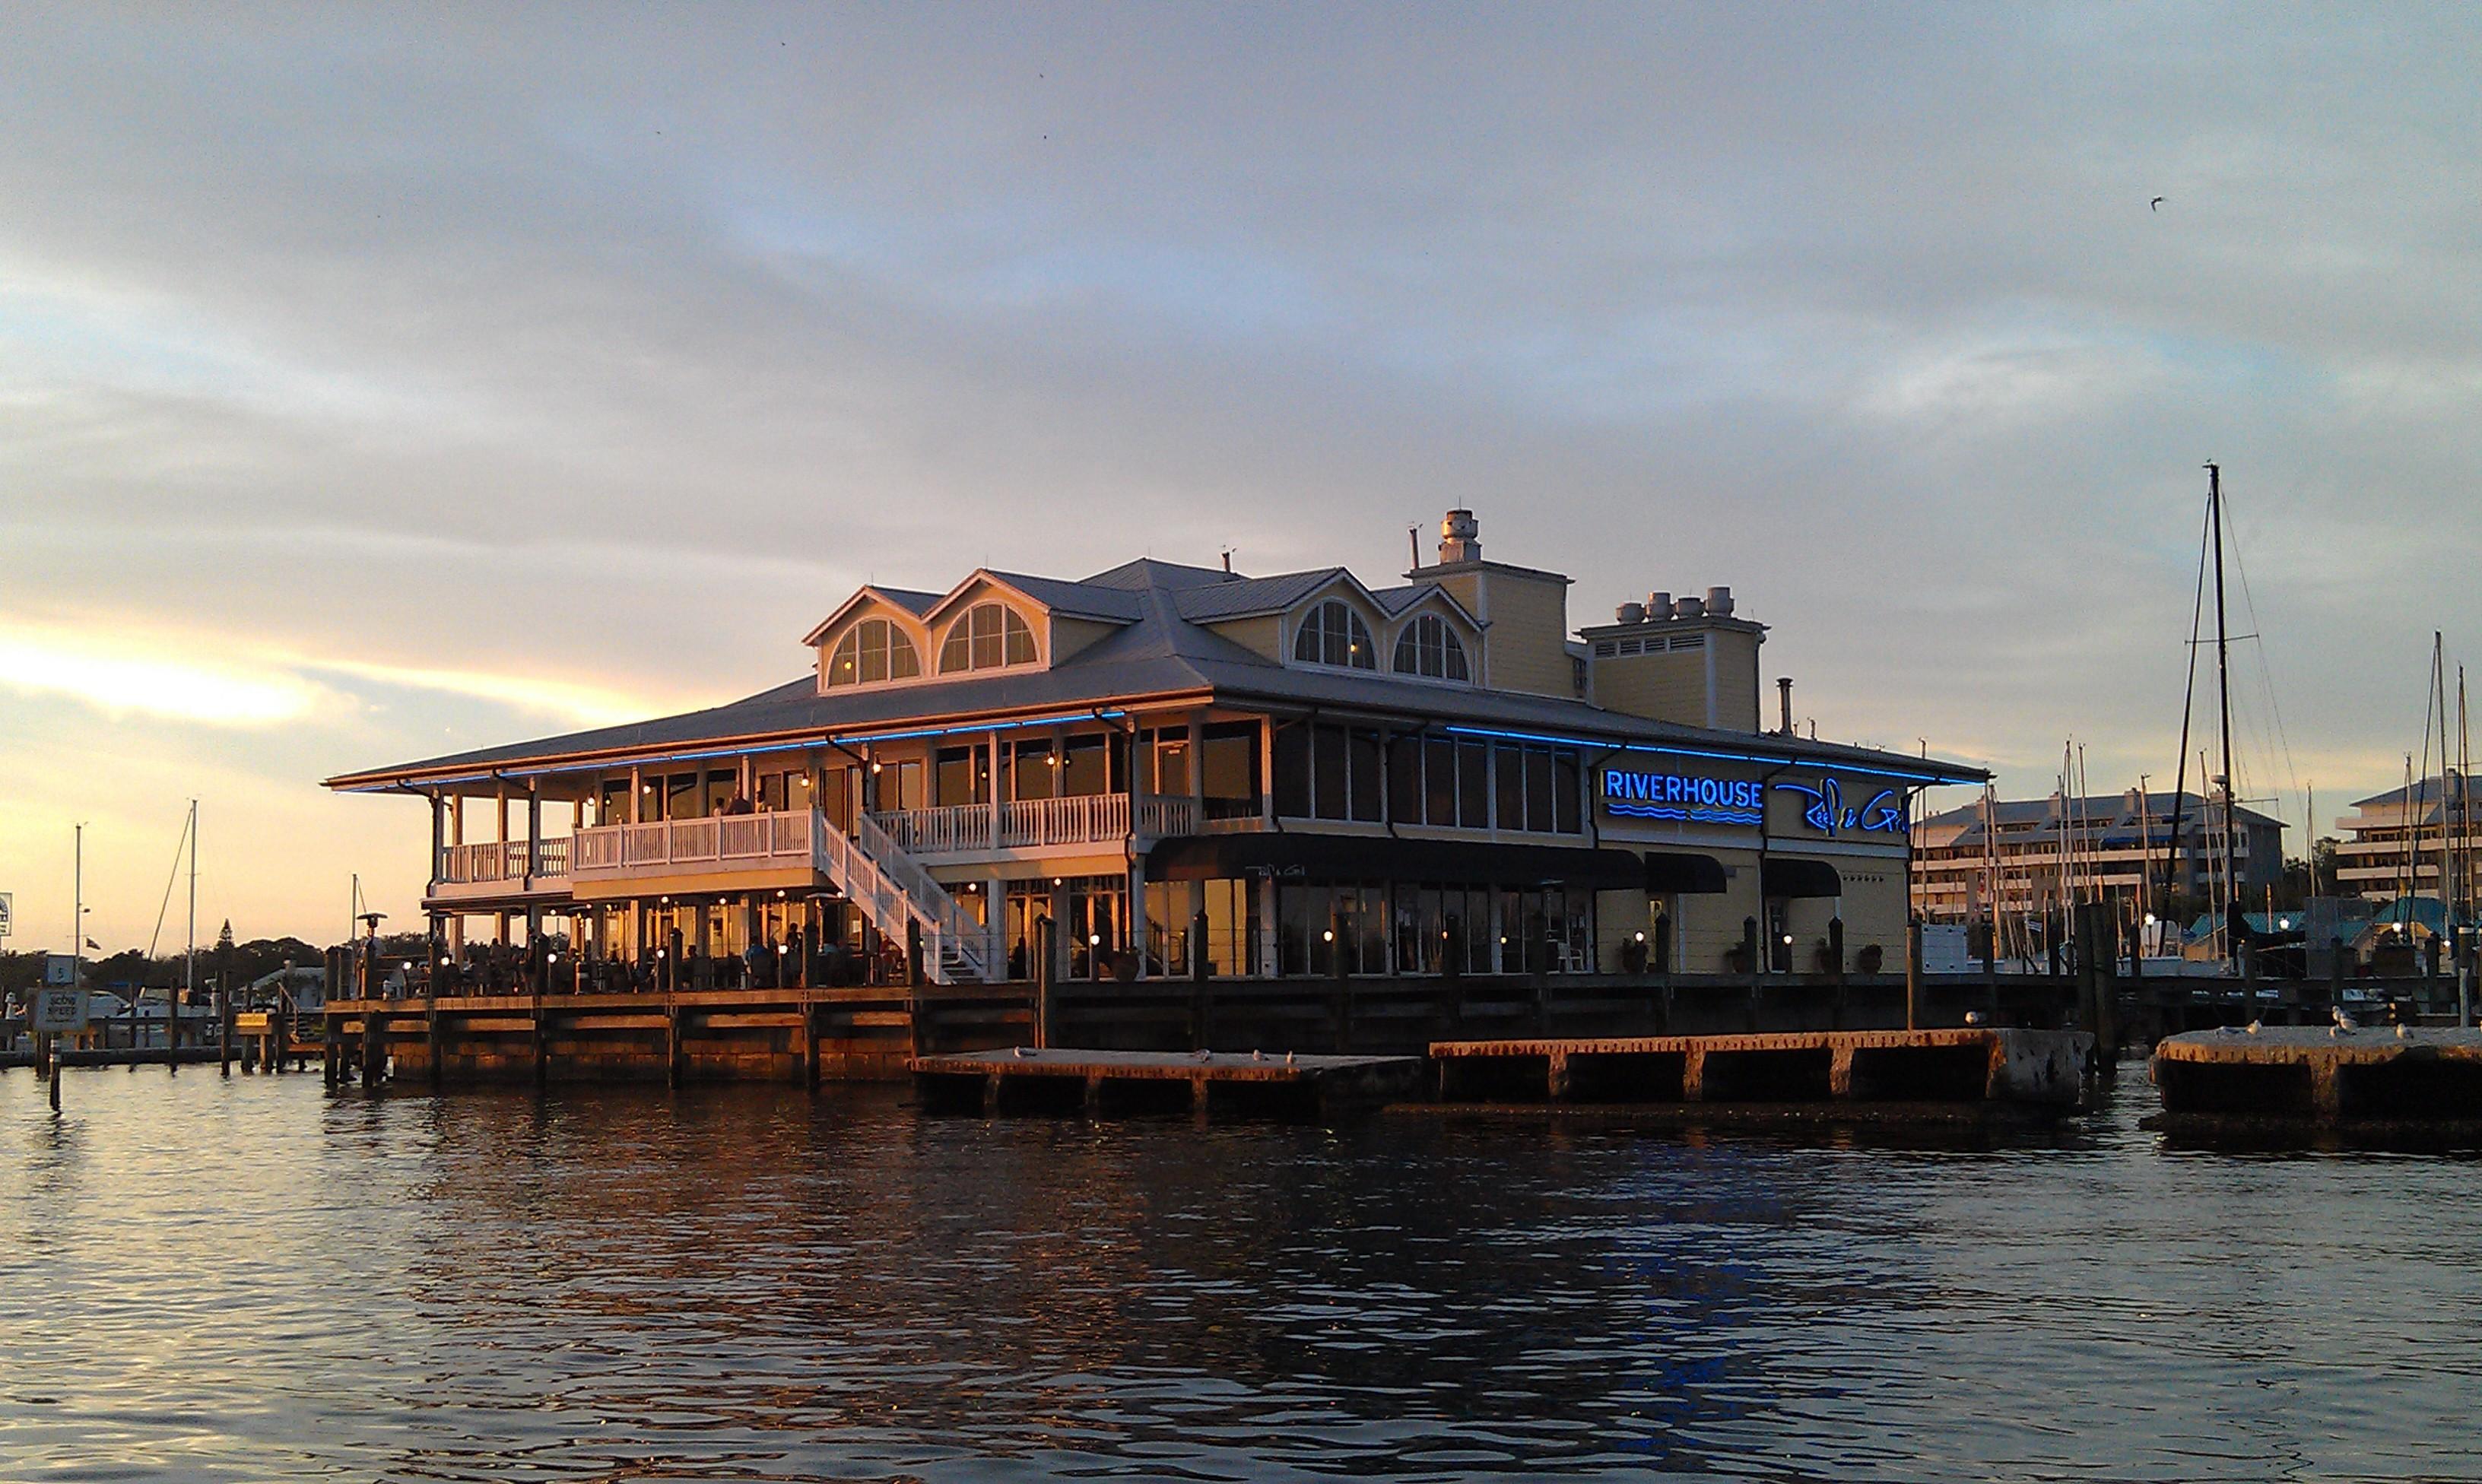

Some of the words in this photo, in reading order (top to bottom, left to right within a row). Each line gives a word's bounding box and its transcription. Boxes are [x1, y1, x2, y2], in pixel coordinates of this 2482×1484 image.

[1604, 769, 1763, 808] RIVERHOUSE
[1774, 777, 1842, 836] Reef
[1843, 807, 1857, 829] &
